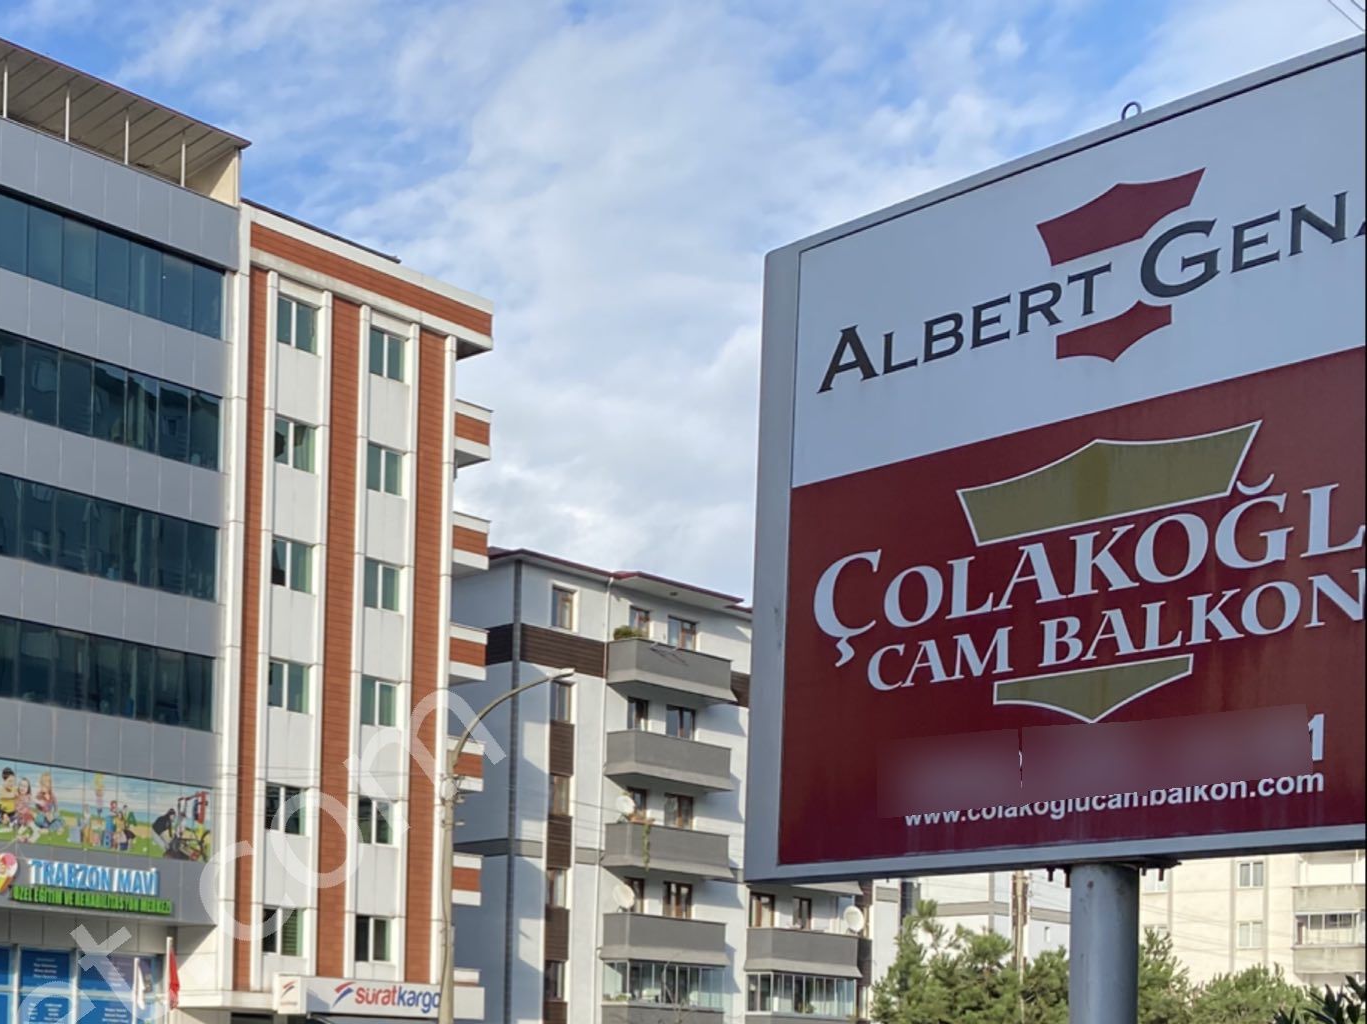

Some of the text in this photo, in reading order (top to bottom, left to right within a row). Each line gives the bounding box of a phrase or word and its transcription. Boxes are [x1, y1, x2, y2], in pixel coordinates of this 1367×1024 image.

[818, 190, 1365, 393] ALBERT GEN
[813, 473, 1365, 667] ÇOLAKOĞL
[867, 568, 1365, 691] CAM BALKON
[28, 859, 160, 896] TRABZON MAVİ
